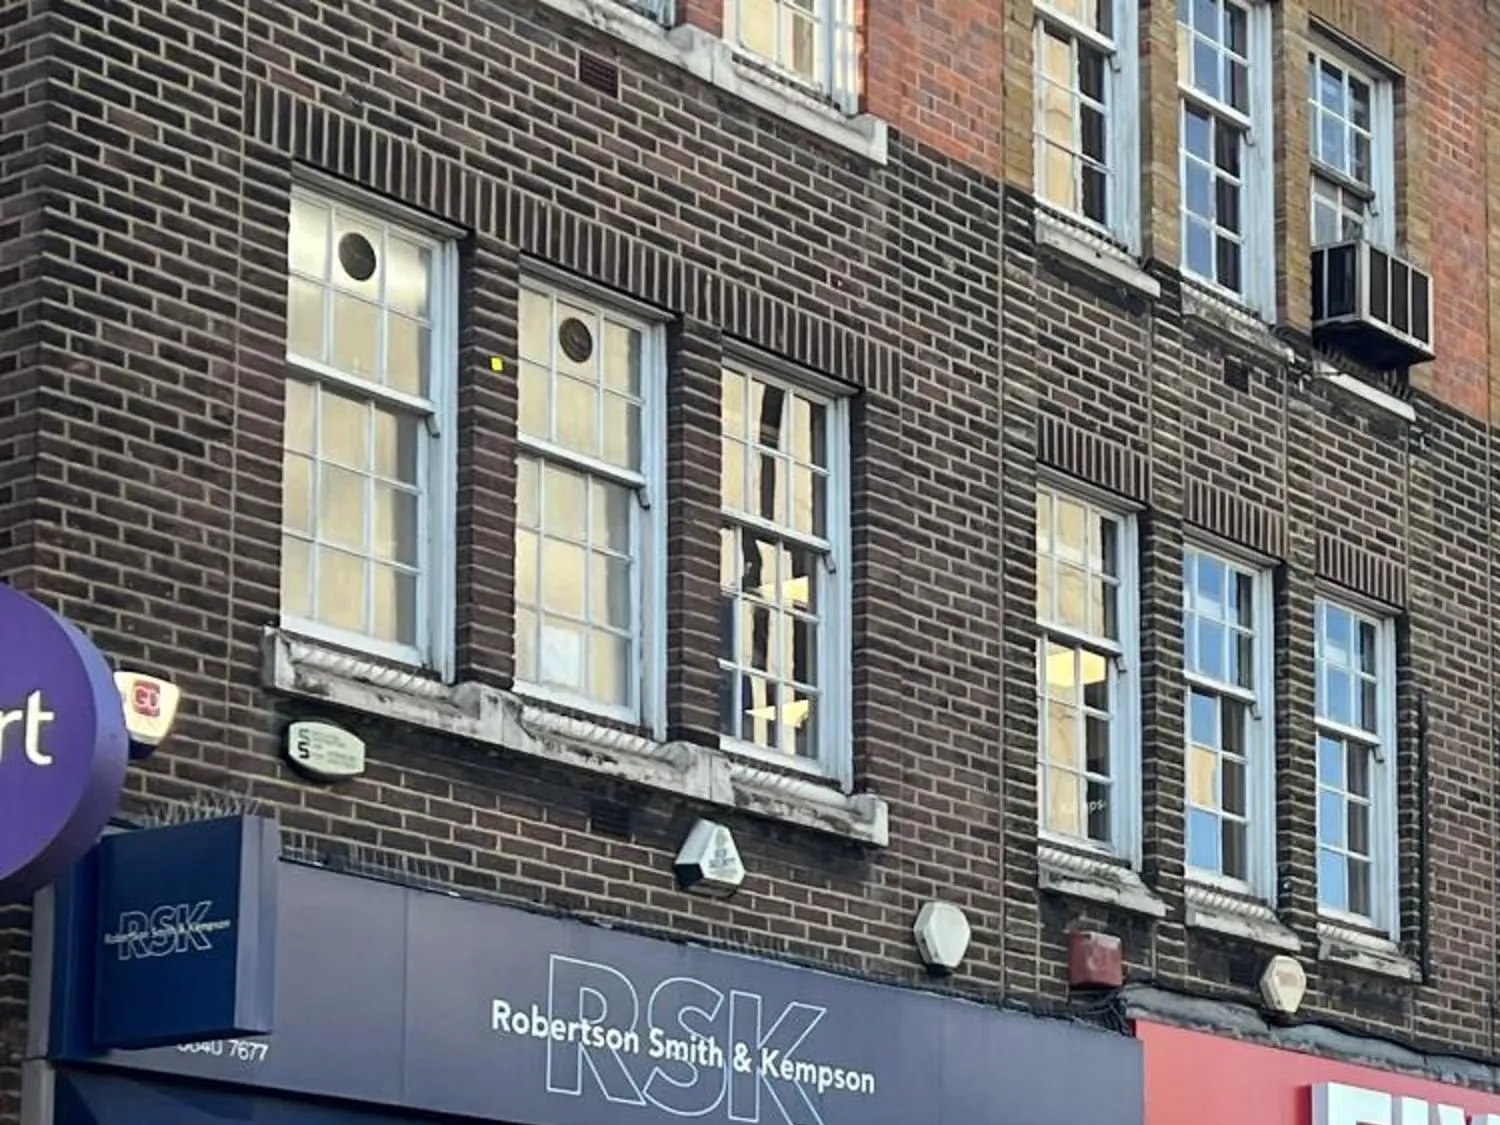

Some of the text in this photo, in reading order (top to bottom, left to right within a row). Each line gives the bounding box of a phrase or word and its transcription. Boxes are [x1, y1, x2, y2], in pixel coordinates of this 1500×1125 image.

[118, 900, 213, 961] RSK
[491, 999, 876, 1095] Robertson Smith & Kempson
